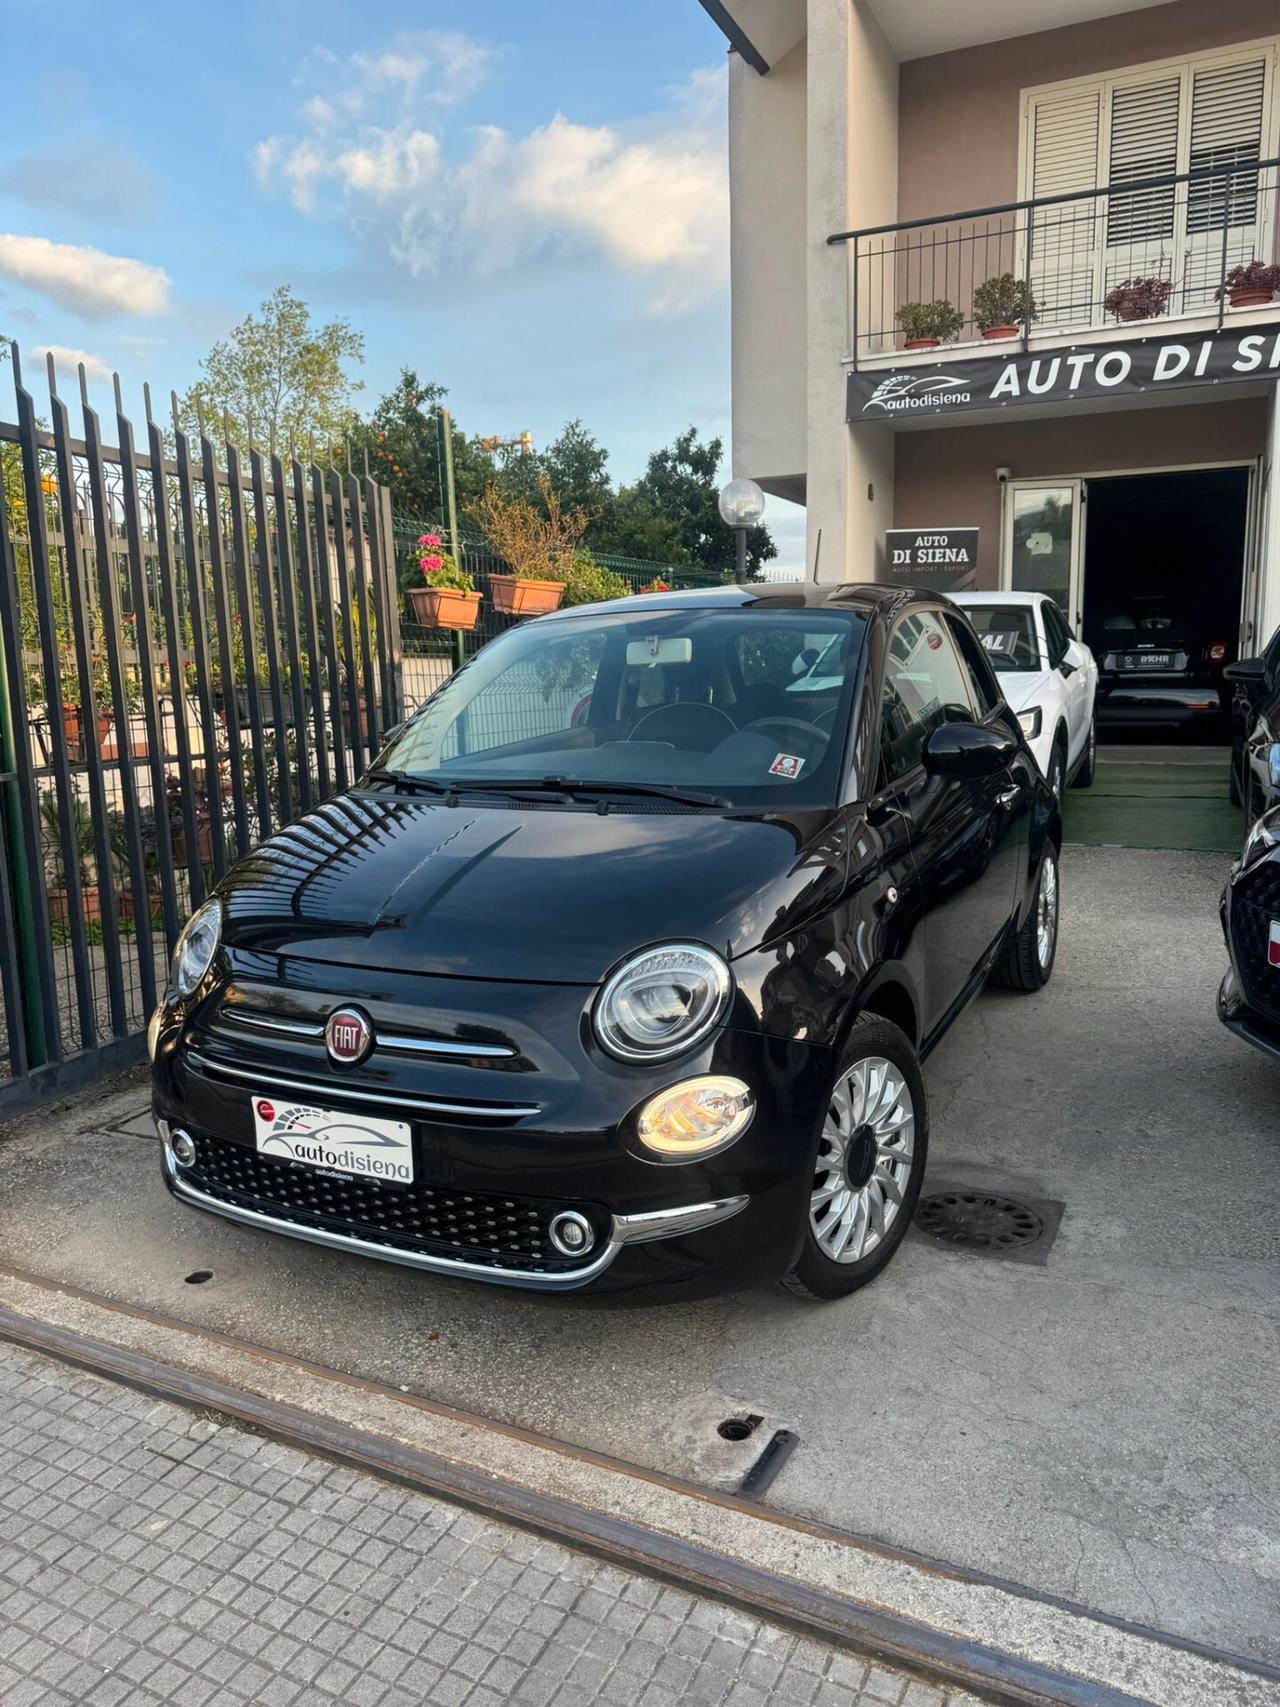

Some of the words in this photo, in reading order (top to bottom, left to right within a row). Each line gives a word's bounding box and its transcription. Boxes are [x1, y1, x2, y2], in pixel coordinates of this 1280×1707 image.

[989, 350, 1131, 399] AUTO
[1152, 340, 1213, 381] DI
[887, 391, 971, 410] autodisiena
[914, 535, 949, 547] AUTO
[892, 549, 912, 564] DI
[917, 548, 969, 563] SIENA
[334, 1025, 359, 1050] FIAT
[295, 1144, 410, 1179] autodisiena
[315, 1168, 354, 1182] autodisiena
